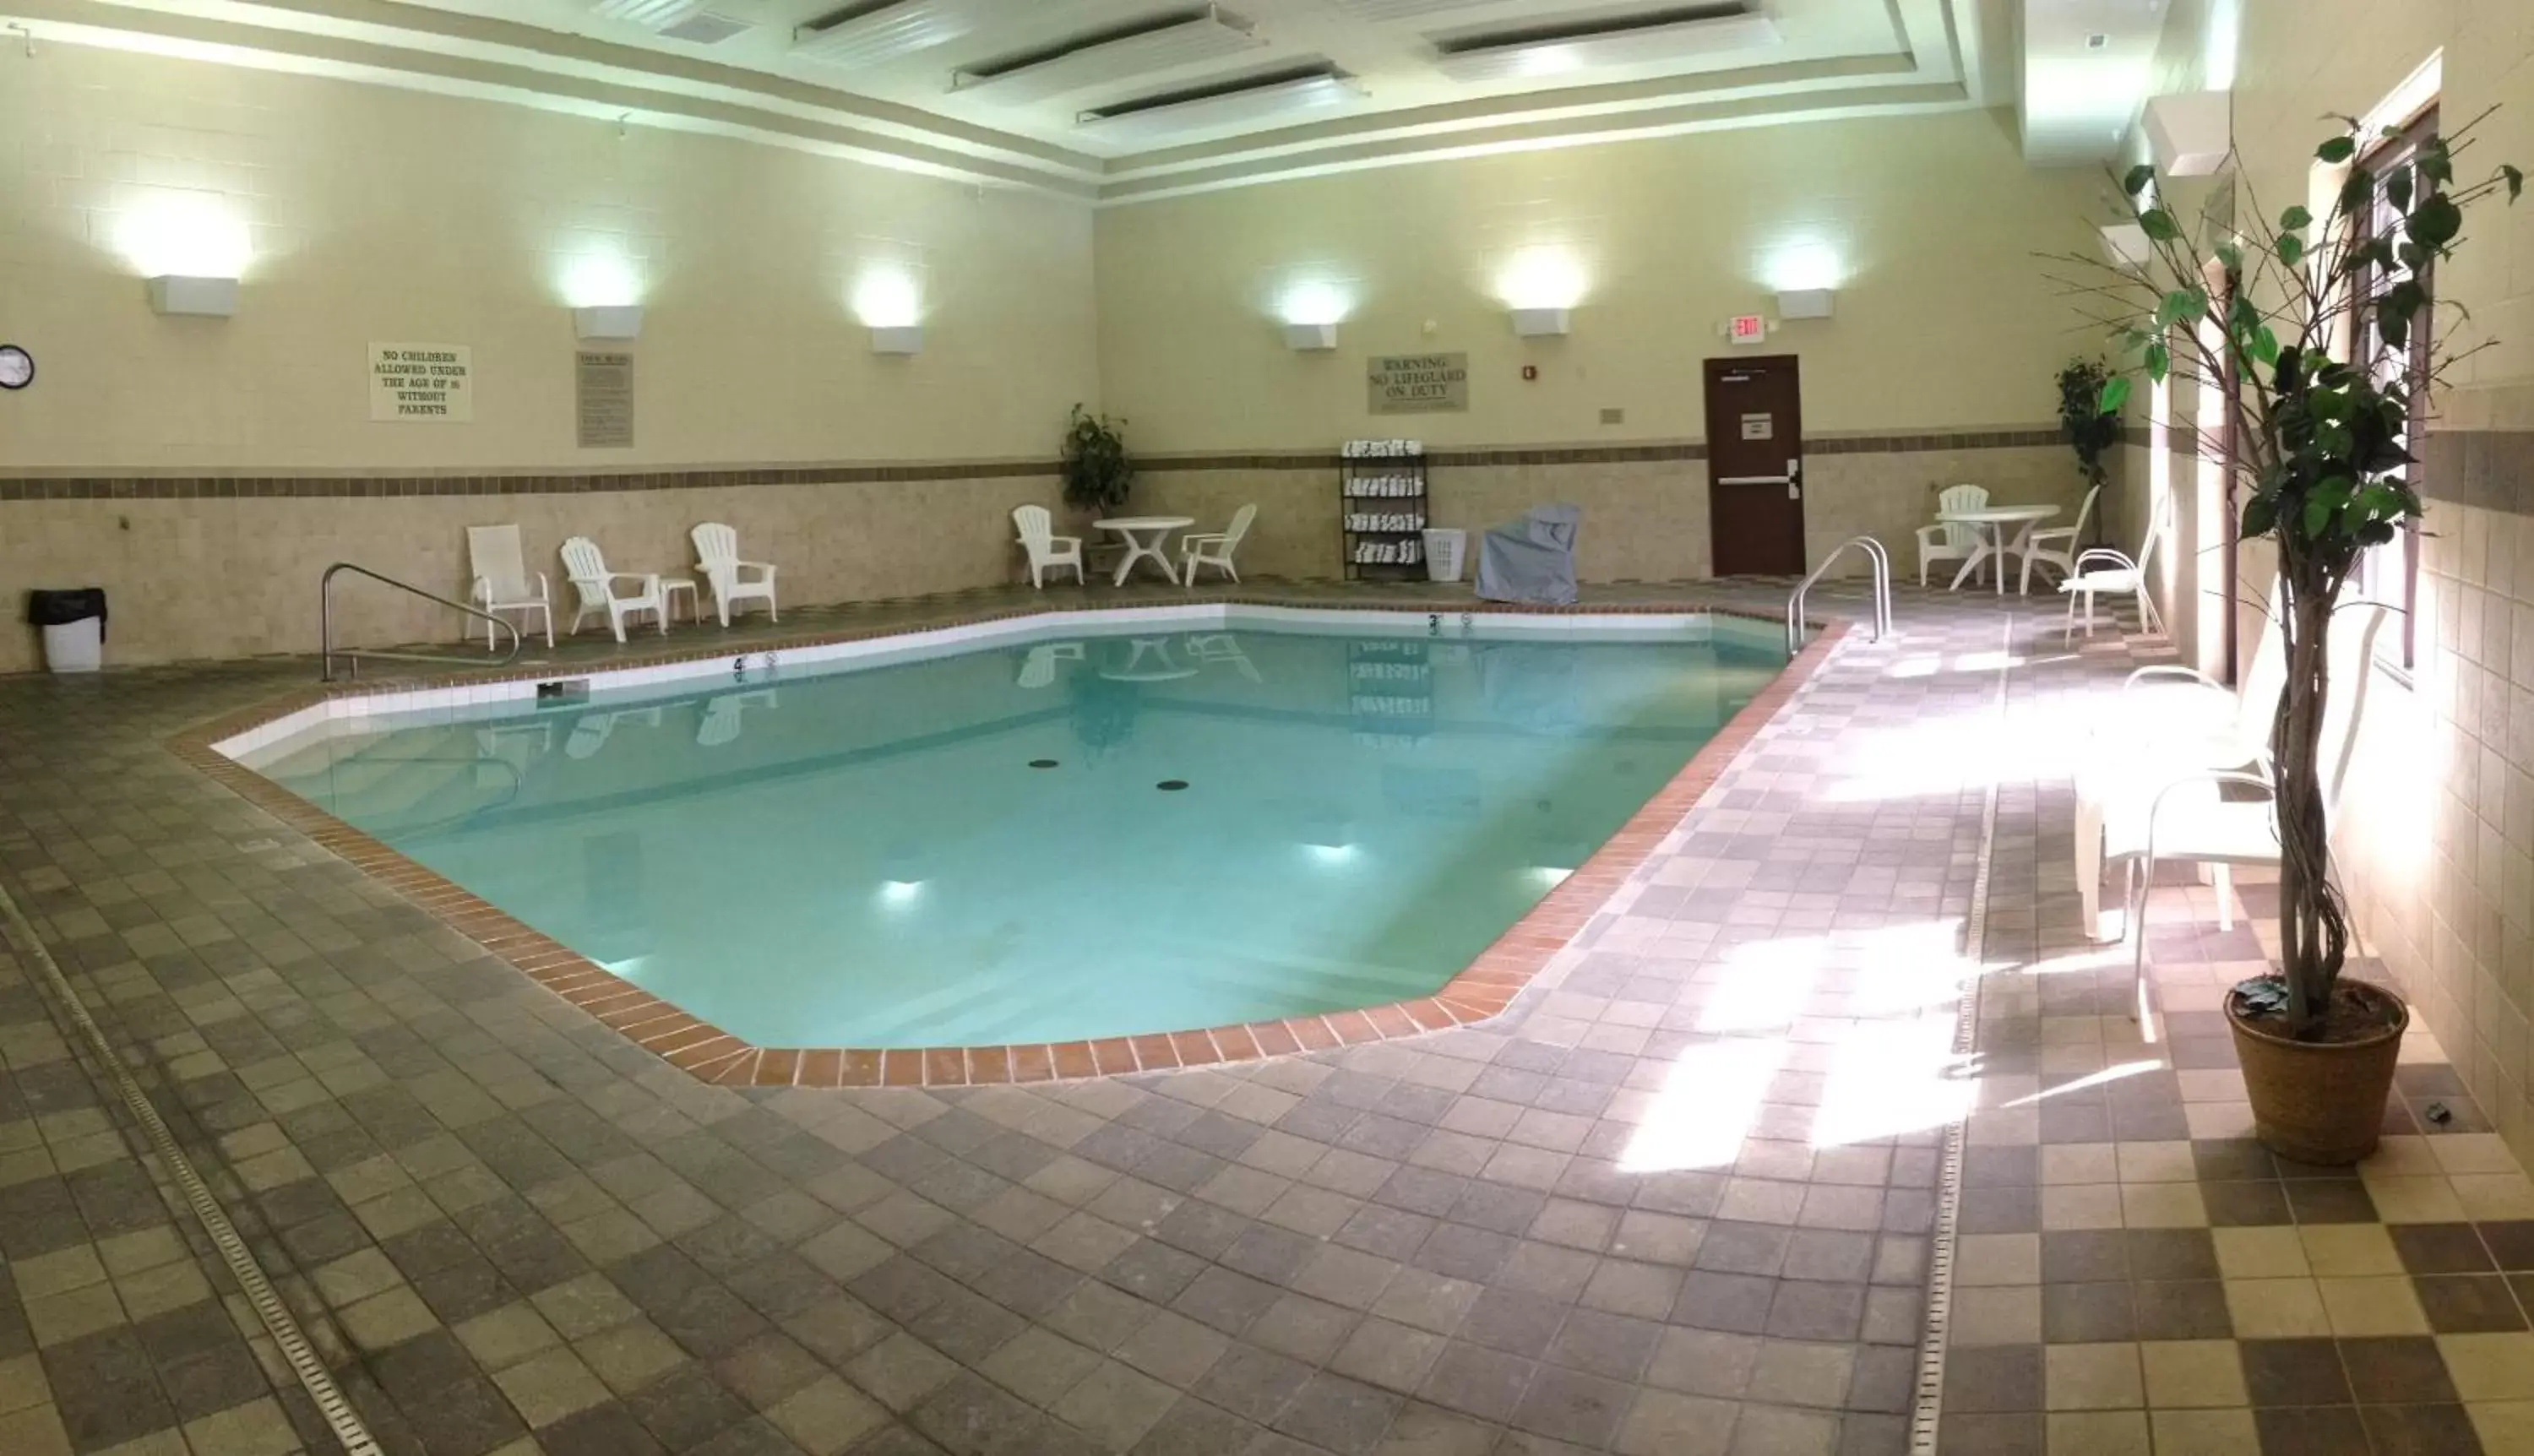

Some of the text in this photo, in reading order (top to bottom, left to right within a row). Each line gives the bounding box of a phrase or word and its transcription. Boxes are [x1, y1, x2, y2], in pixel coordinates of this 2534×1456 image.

[1736, 317, 1758, 336] EXIT
[383, 350, 457, 362] NO CHILDREN
[374, 363, 466, 376] ALLOWED UNDER
[382, 378, 405, 388] THE
[409, 378, 430, 388] AGE
[434, 378, 447, 388] OF
[1369, 368, 1466, 386] NO LIFEGUARD
[397, 391, 446, 401] WITHOUT
[1386, 383, 1447, 397] ON DUTY
[398, 405, 447, 415] PARENTS
